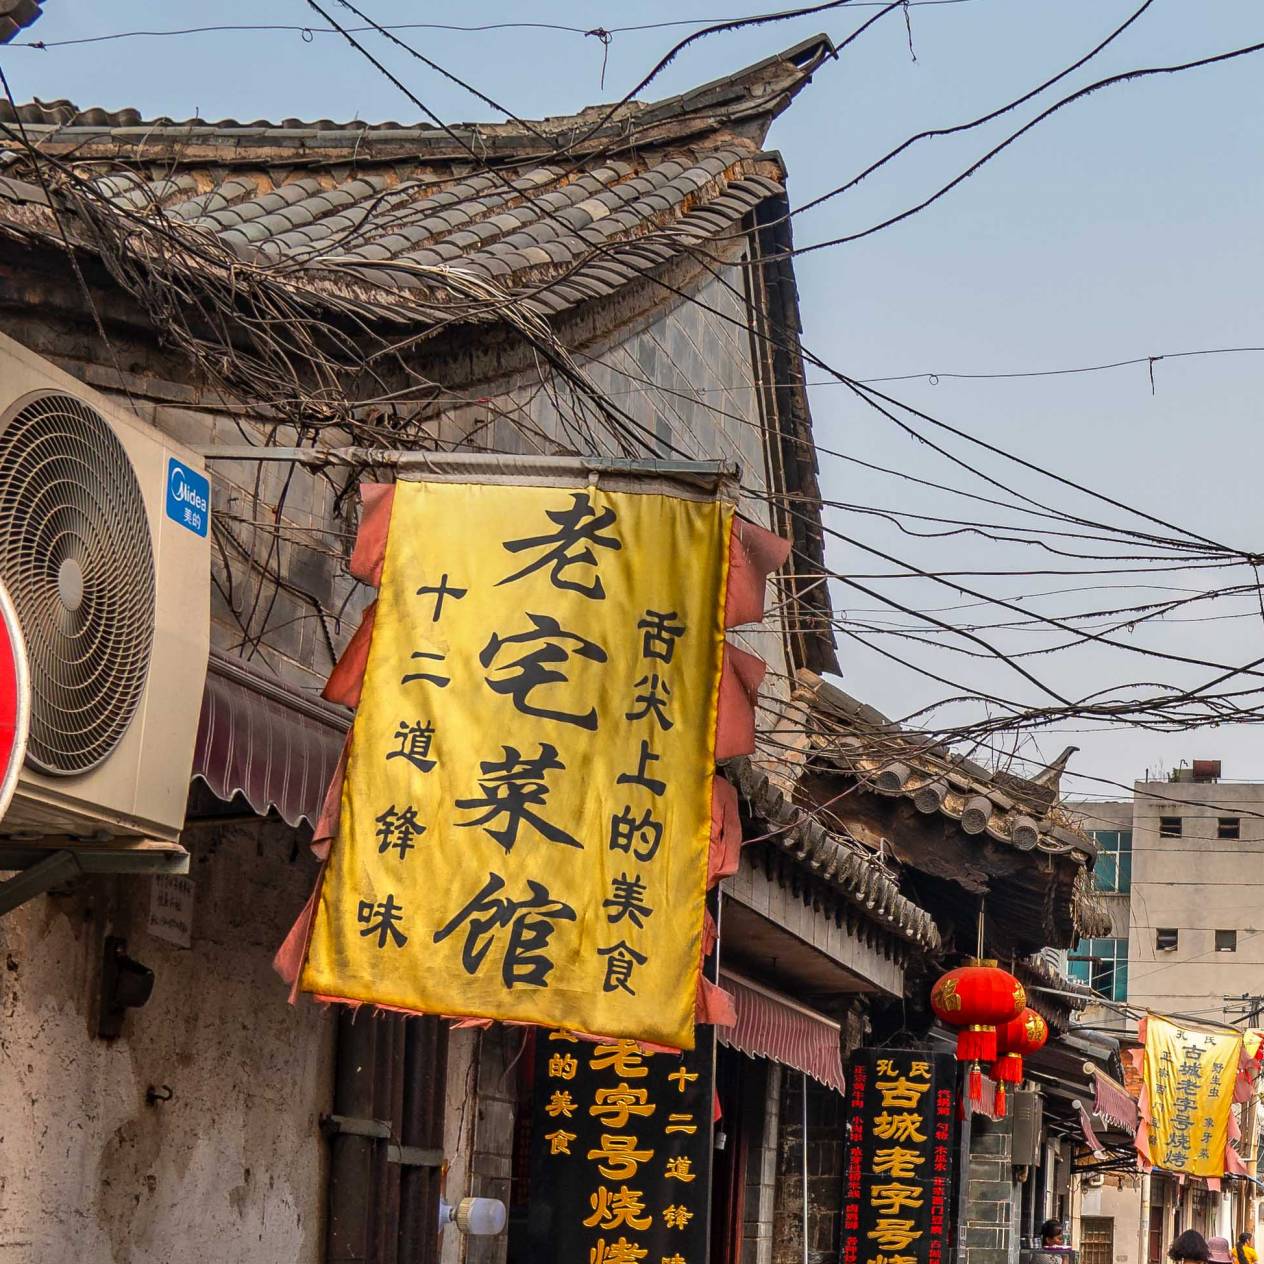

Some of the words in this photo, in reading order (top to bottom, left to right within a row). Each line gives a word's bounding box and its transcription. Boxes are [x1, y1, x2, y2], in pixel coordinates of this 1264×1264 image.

[172, 472, 206, 512] Midea
[183, 507, 202, 530] 美的
[357, 574, 468, 949] 十二道锋味
[433, 492, 623, 989] 老宅菜馆
[596, 609, 687, 996] 舌尖上的美食
[876, 1059, 932, 1079] 孔氏
[1163, 1044, 1207, 1168] 古城老字号烧烤
